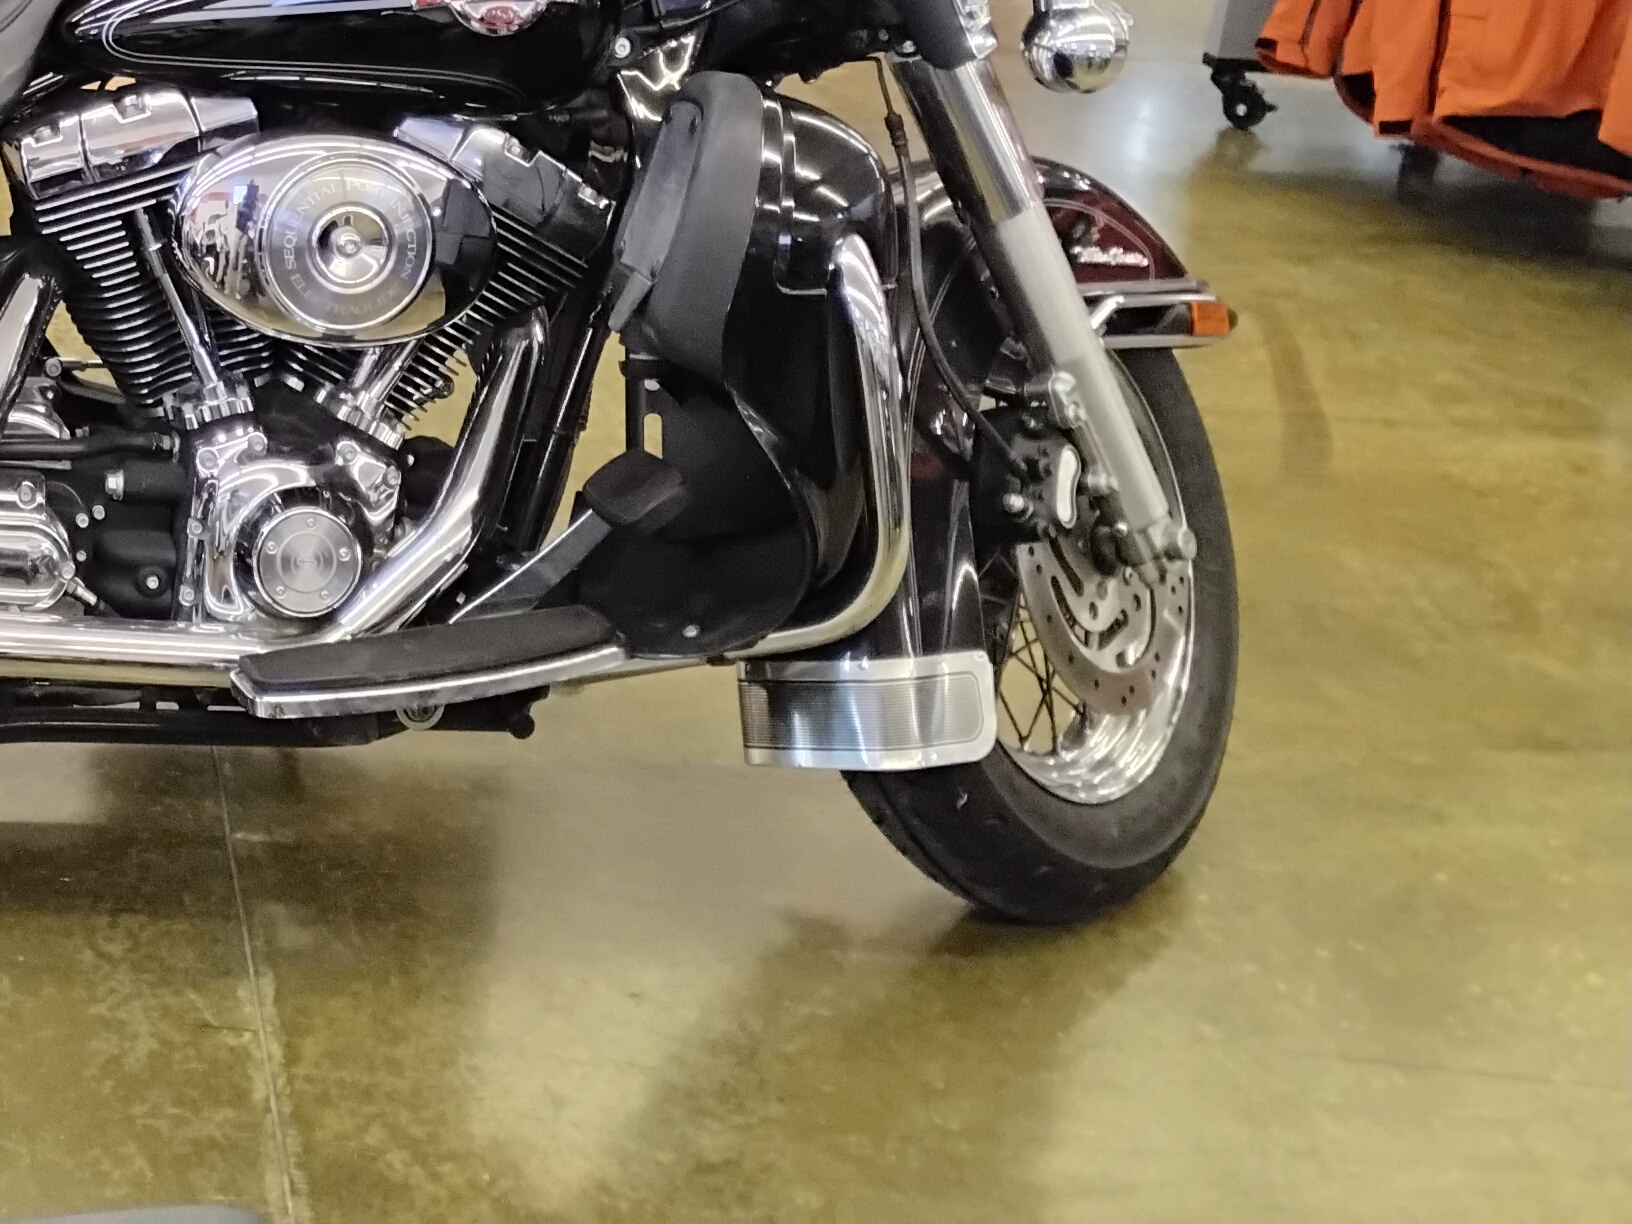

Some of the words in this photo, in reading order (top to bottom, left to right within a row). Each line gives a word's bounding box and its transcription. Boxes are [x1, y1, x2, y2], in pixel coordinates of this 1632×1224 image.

[284, 181, 342, 270] SEQUENTIAL
[346, 180, 390, 200] PORT
[389, 196, 418, 281] INJECTION
